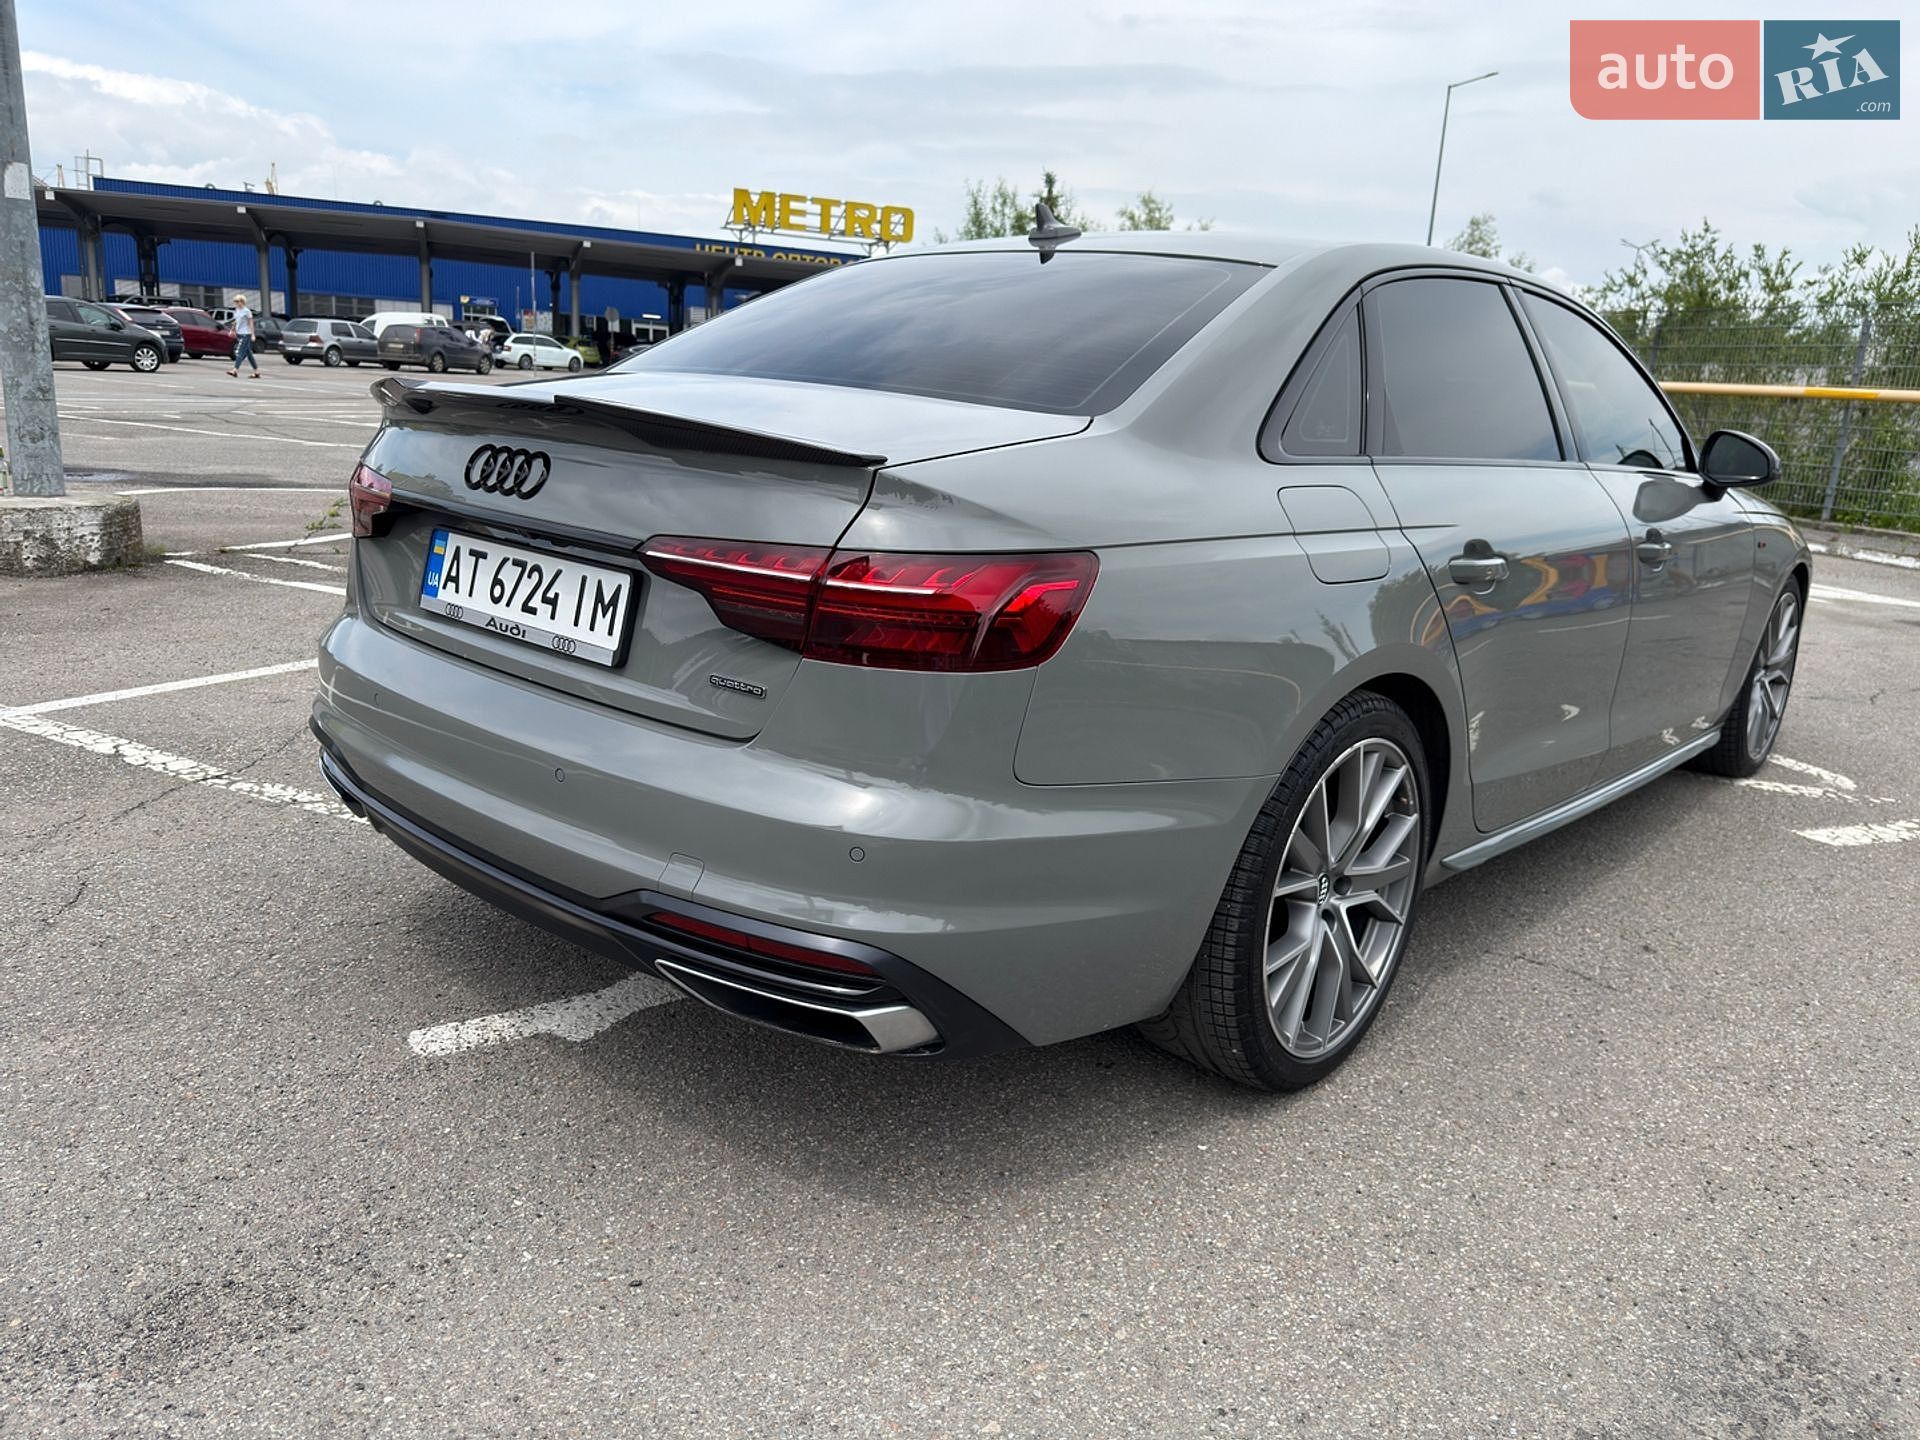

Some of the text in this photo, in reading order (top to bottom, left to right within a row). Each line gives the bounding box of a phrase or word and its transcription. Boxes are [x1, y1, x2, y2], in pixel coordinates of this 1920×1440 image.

[733, 188, 915, 243] METRO
[427, 571, 439, 587] UA
[442, 545, 623, 637] AT 6724 IM
[485, 617, 527, 639] Audi
[709, 676, 764, 697] quattro
